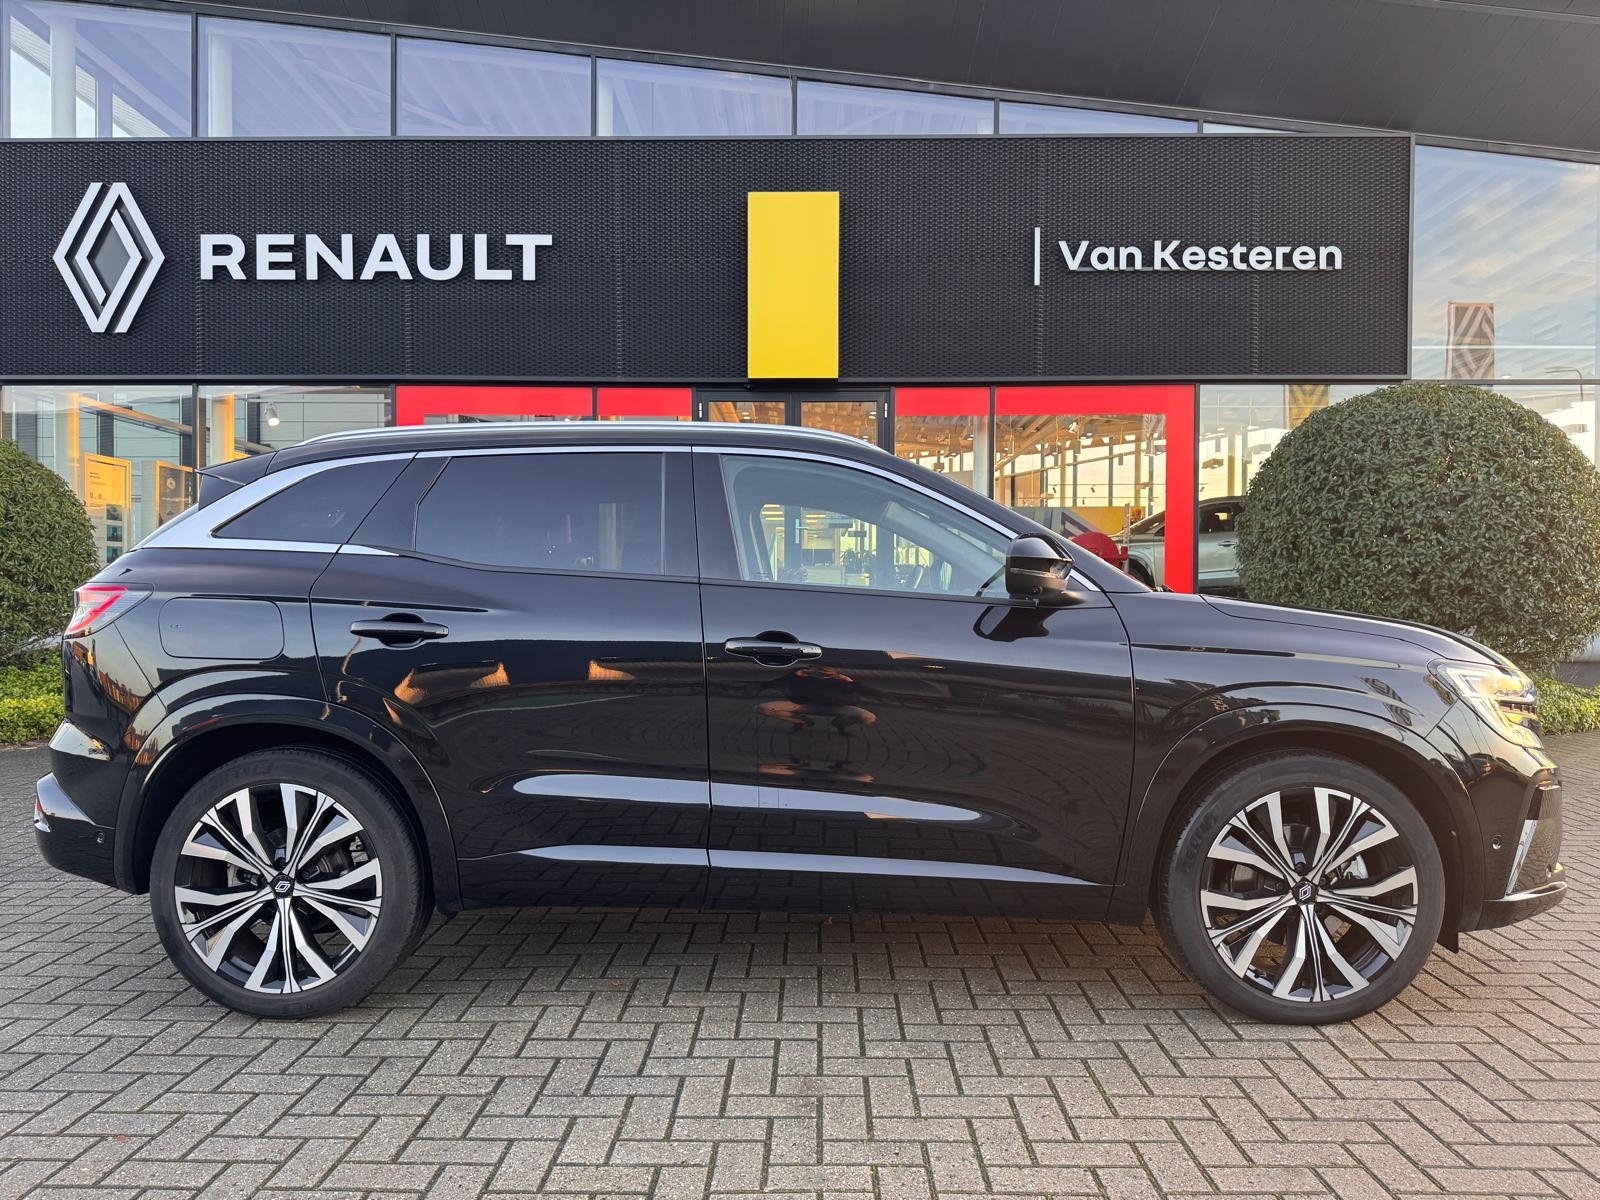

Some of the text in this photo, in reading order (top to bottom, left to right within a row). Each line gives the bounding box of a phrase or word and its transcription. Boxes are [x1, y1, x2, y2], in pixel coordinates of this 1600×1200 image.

[200, 233, 553, 281] RENAULT
[1058, 240, 1343, 271] Van Kesteren
